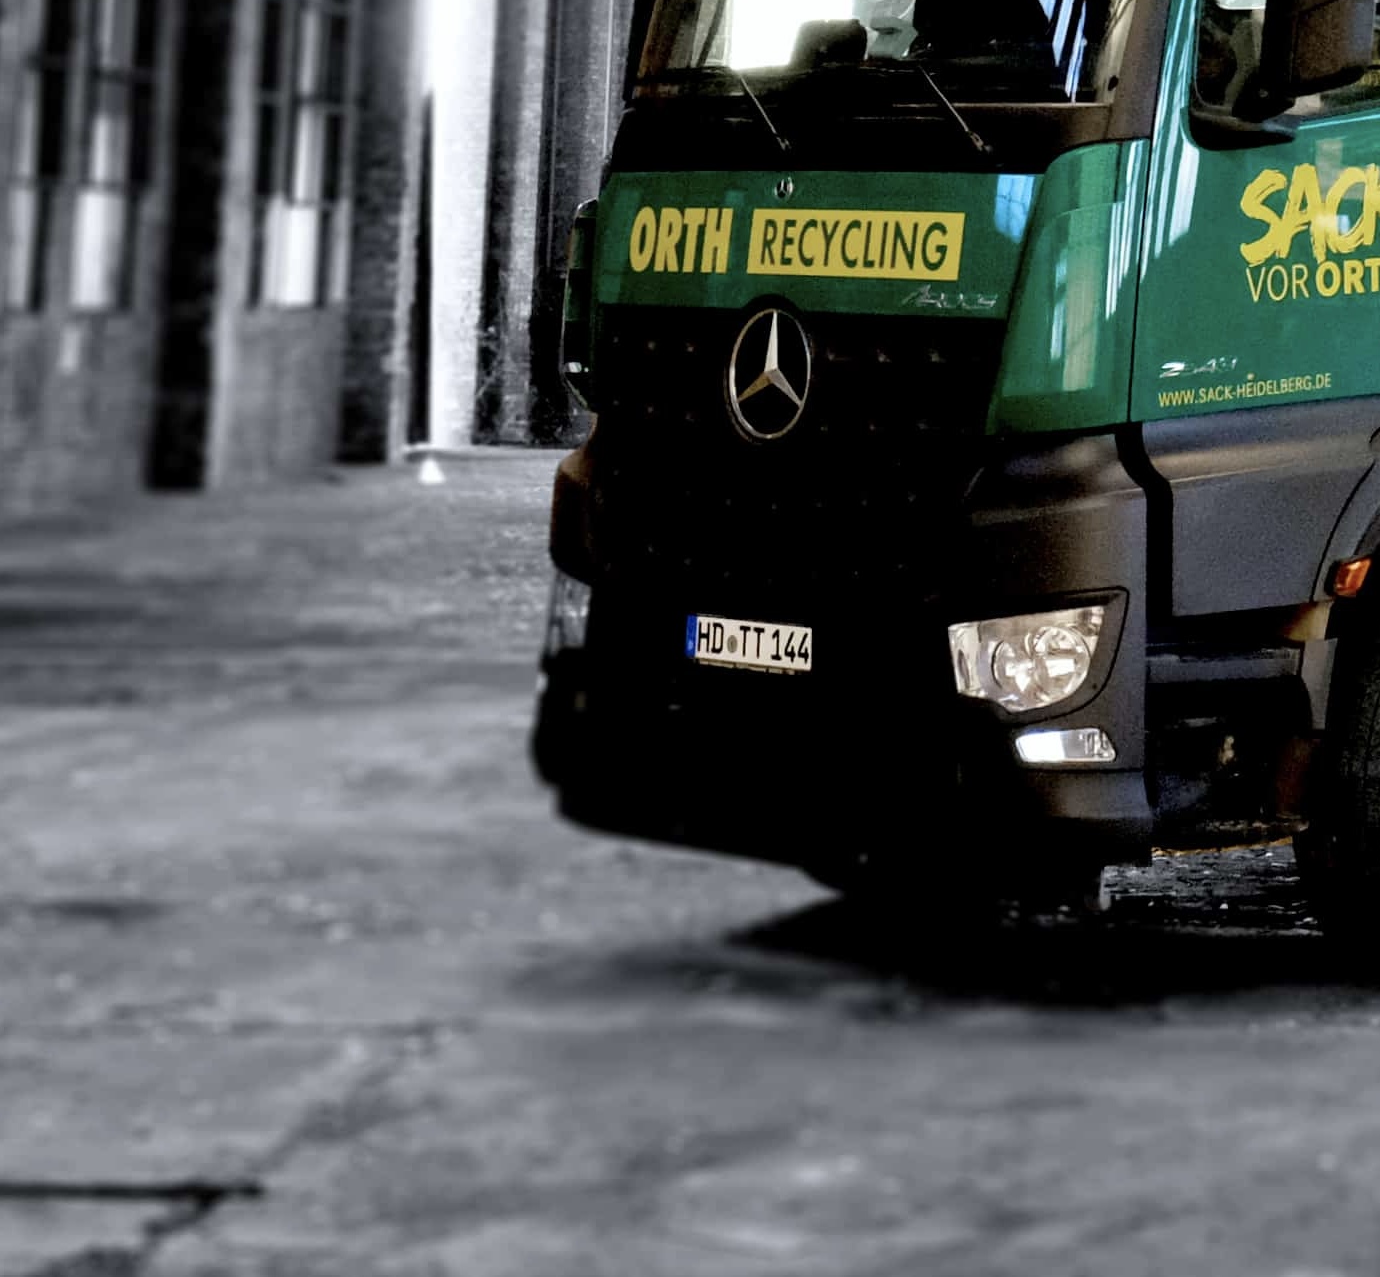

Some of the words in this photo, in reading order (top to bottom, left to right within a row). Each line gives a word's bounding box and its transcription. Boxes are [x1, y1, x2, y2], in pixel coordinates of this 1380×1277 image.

[628, 205, 734, 275] ORTH
[759, 218, 949, 272] RECYCLING
[1246, 265, 1309, 302] VOR
[1158, 373, 1332, 407] WWW.SACK-HEIDELBERG.DE
[698, 622, 724, 653] HD
[740, 626, 765, 658] TT
[771, 629, 809, 663] 144
